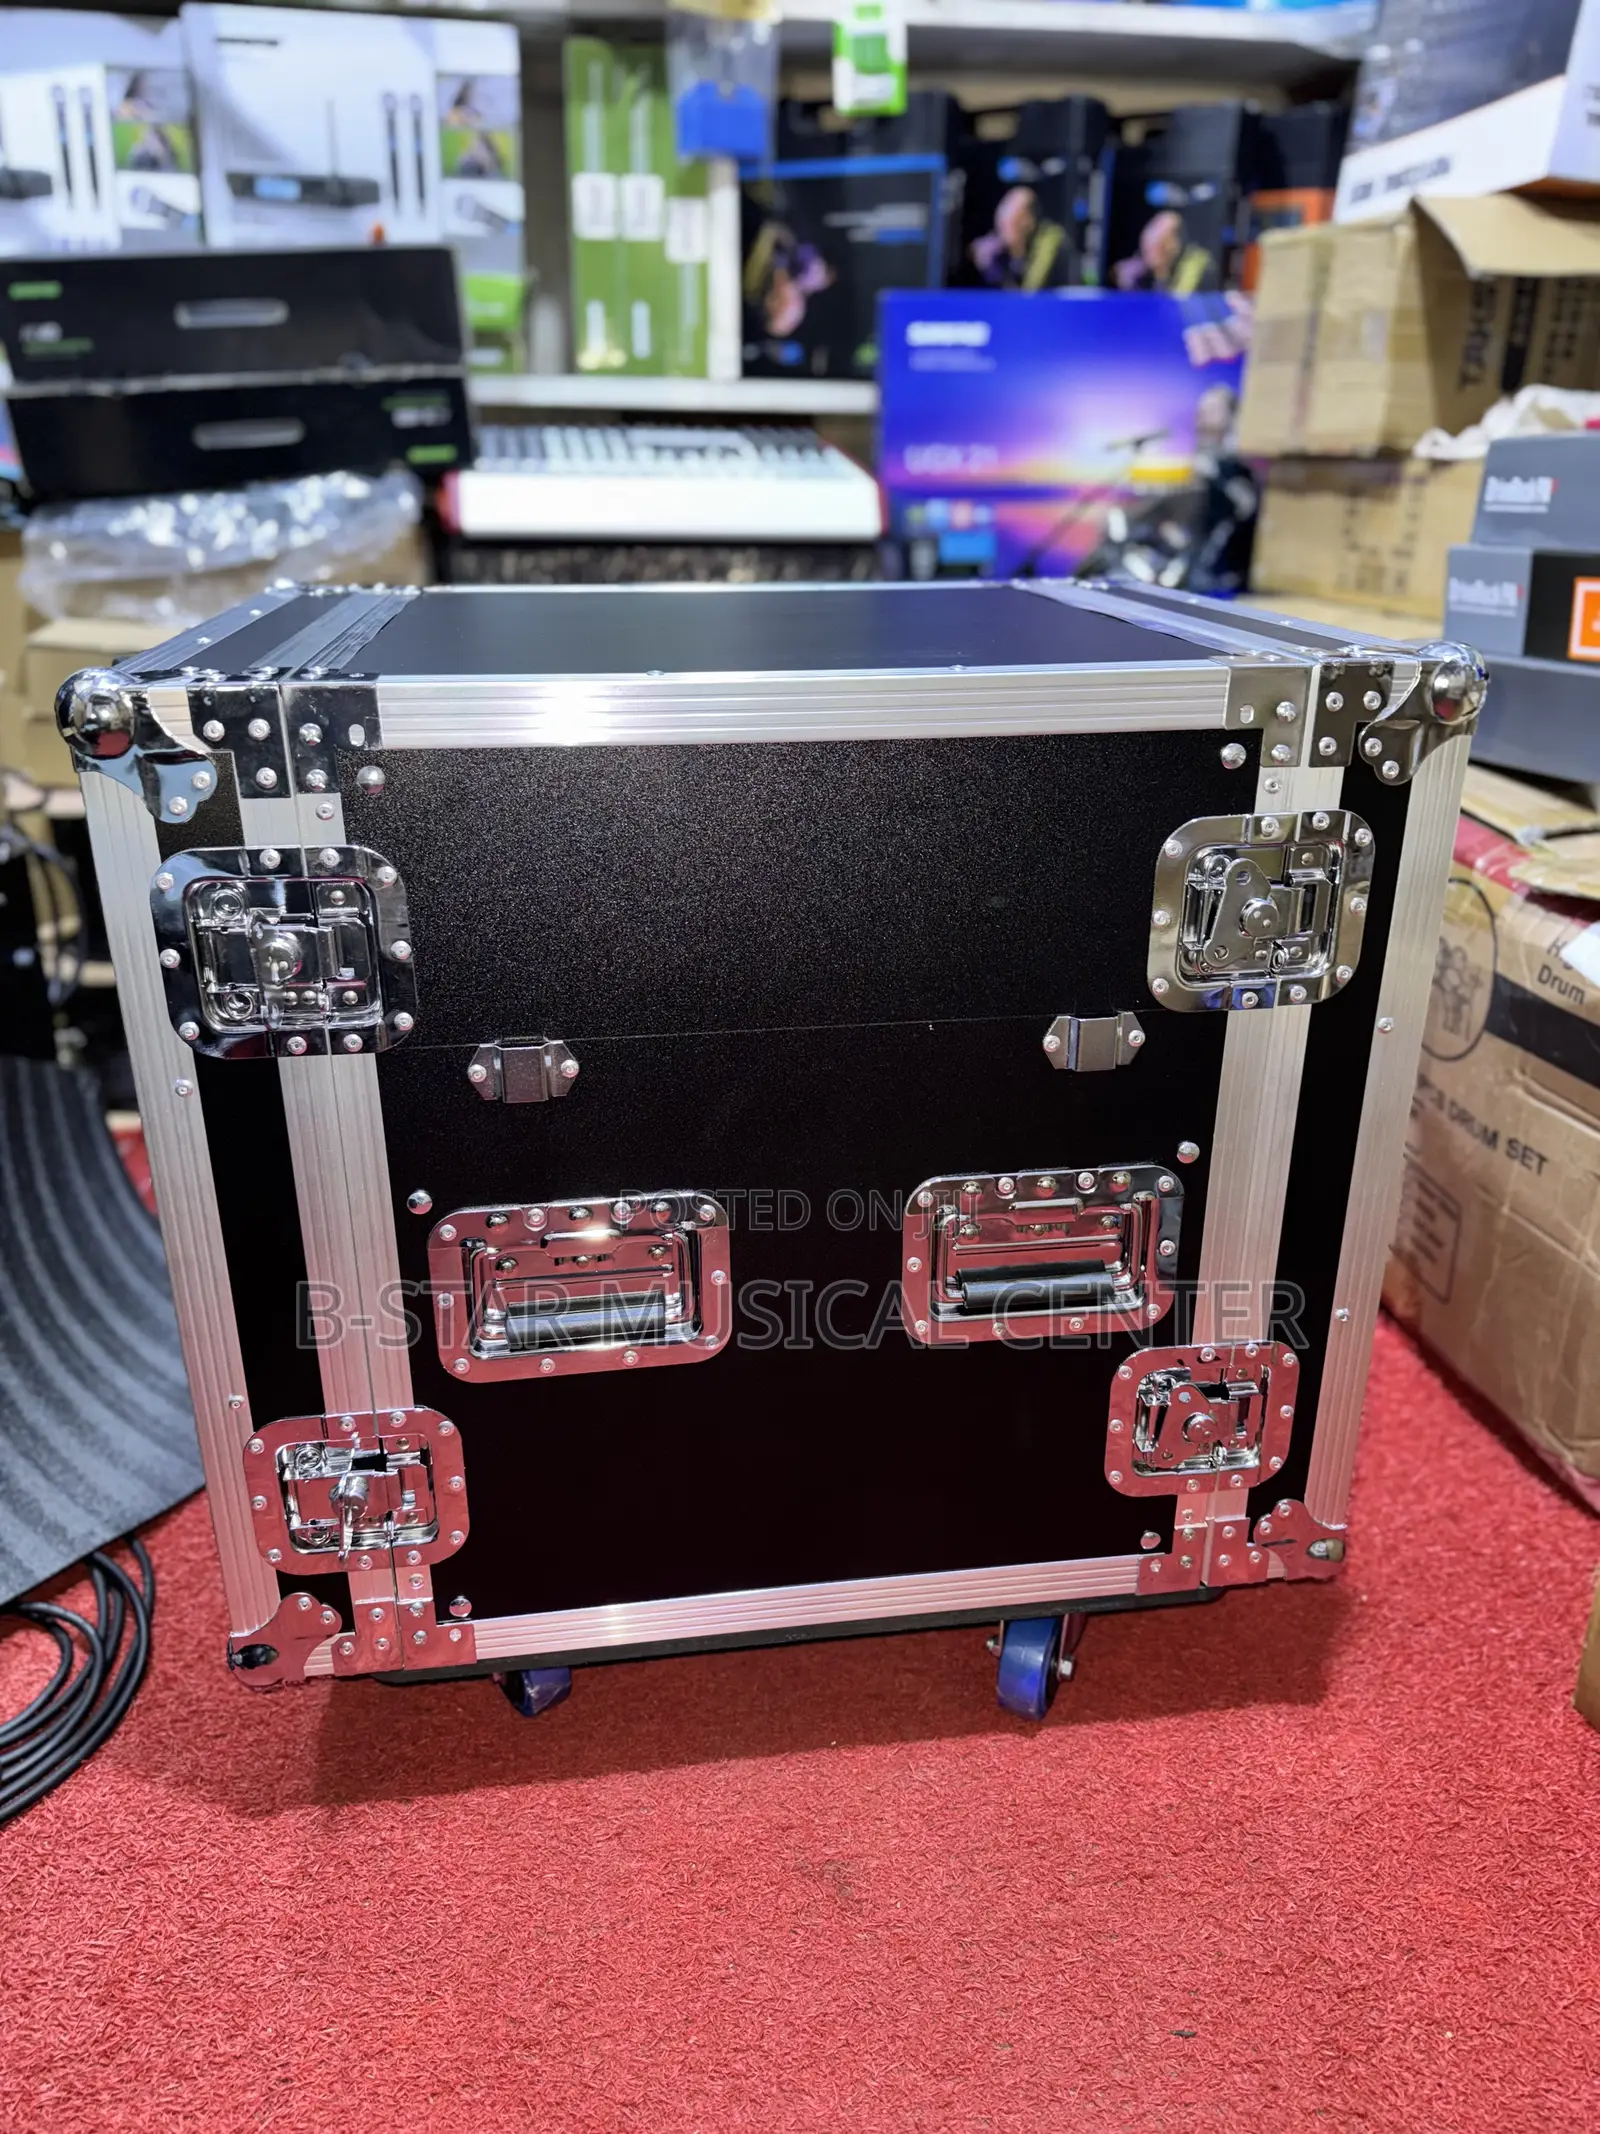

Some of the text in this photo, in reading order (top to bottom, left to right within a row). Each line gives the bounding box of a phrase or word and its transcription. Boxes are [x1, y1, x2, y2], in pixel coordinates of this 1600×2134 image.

[1537, 963, 1586, 1006] Drum
[1449, 1099, 1549, 1177] DRUM SET
